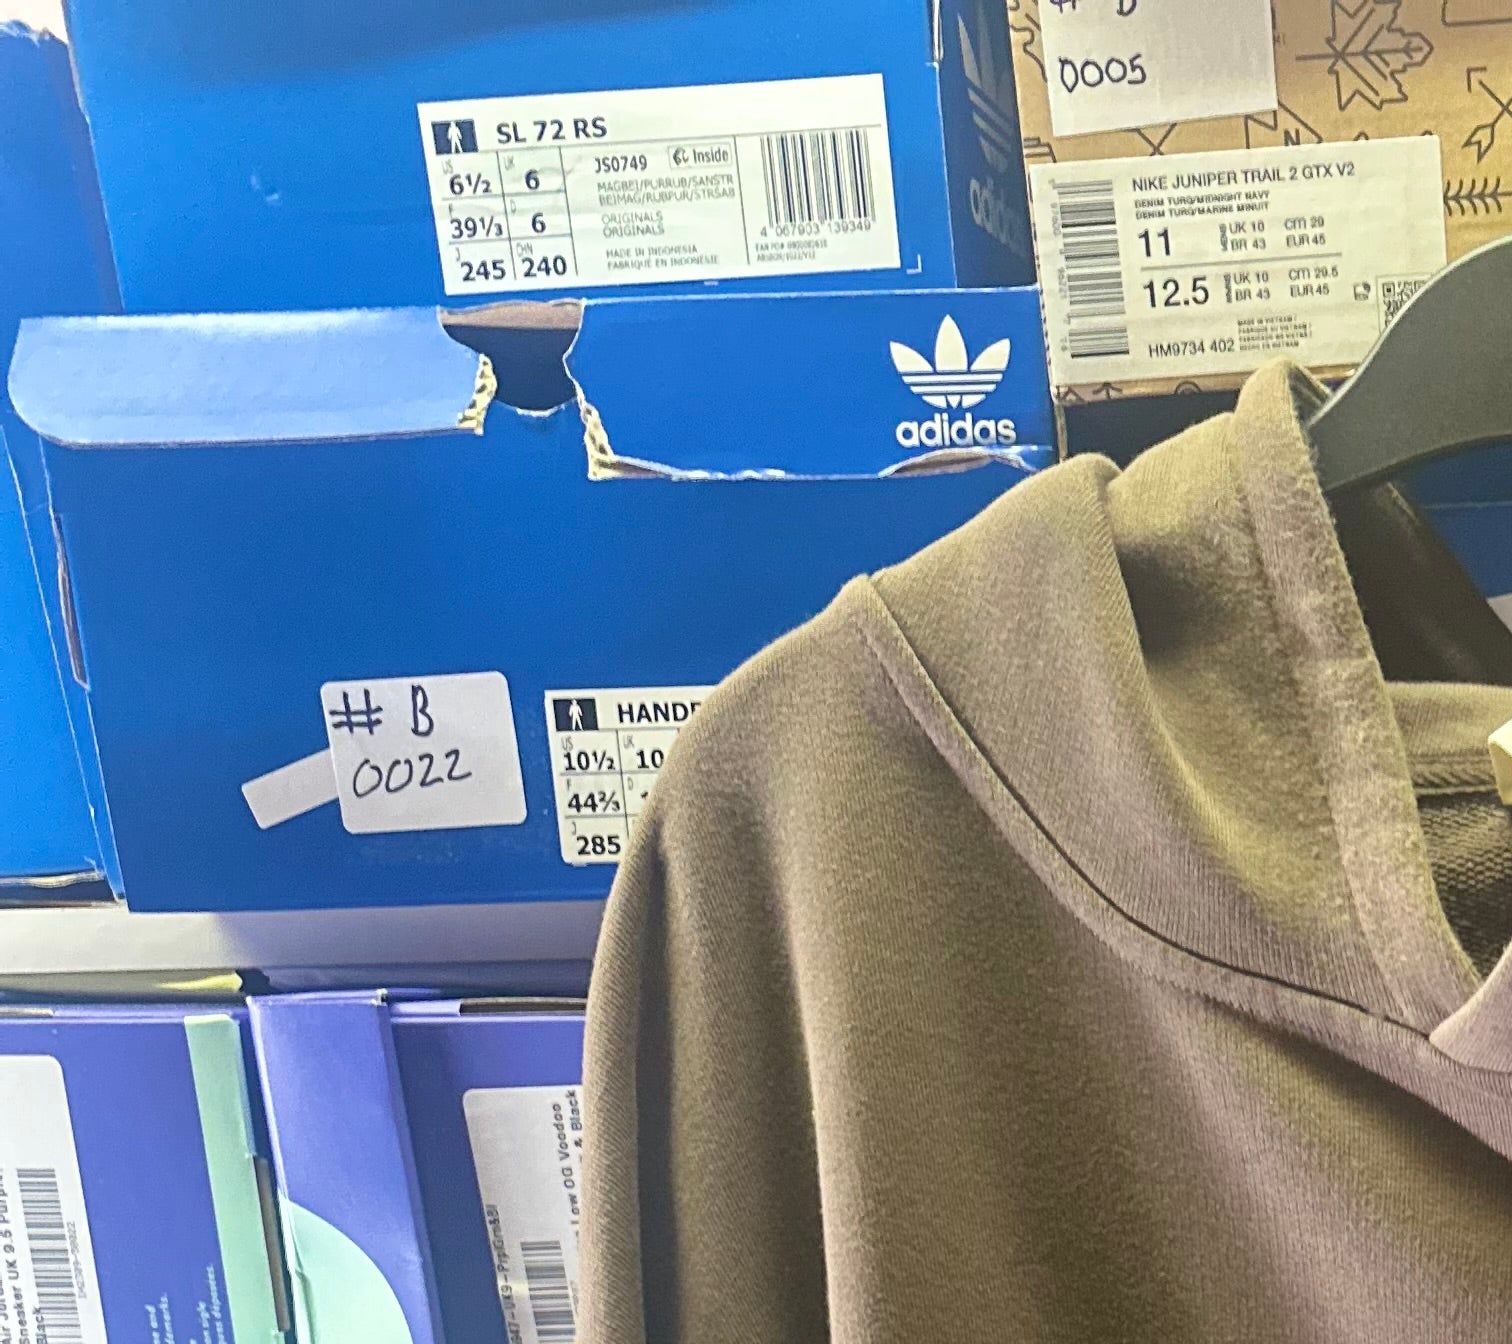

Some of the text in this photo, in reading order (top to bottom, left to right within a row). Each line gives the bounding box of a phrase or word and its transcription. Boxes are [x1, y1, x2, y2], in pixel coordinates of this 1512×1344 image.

[1058, 53, 1147, 93] 0005
[496, 116, 608, 144] SL 72 RS
[595, 155, 648, 174] JS0749
[693, 148, 729, 163] Inside
[525, 169, 541, 191] 6
[1132, 161, 1355, 192] NIKE JUNIPER TRAIL 2 GTX V2
[531, 212, 547, 234] 6
[601, 211, 664, 226] ORIGINALS
[602, 225, 665, 239] ORIGINALS
[1137, 226, 1172, 258] 11
[460, 255, 567, 283] 245 240
[1255, 271, 1269, 283] 10
[1143, 275, 1210, 309] 12.5
[1148, 337, 1235, 358] HM9734 402
[895, 412, 1017, 449] adidas
[410, 684, 434, 738] B
[352, 749, 473, 799] 0022
[576, 835, 621, 857] 285
[565, 1090, 581, 1131] Black
[550, 1102, 576, 1190] OG Voodoo
[5, 1258, 19, 1281] UK
[145, 1304, 158, 1329] and
